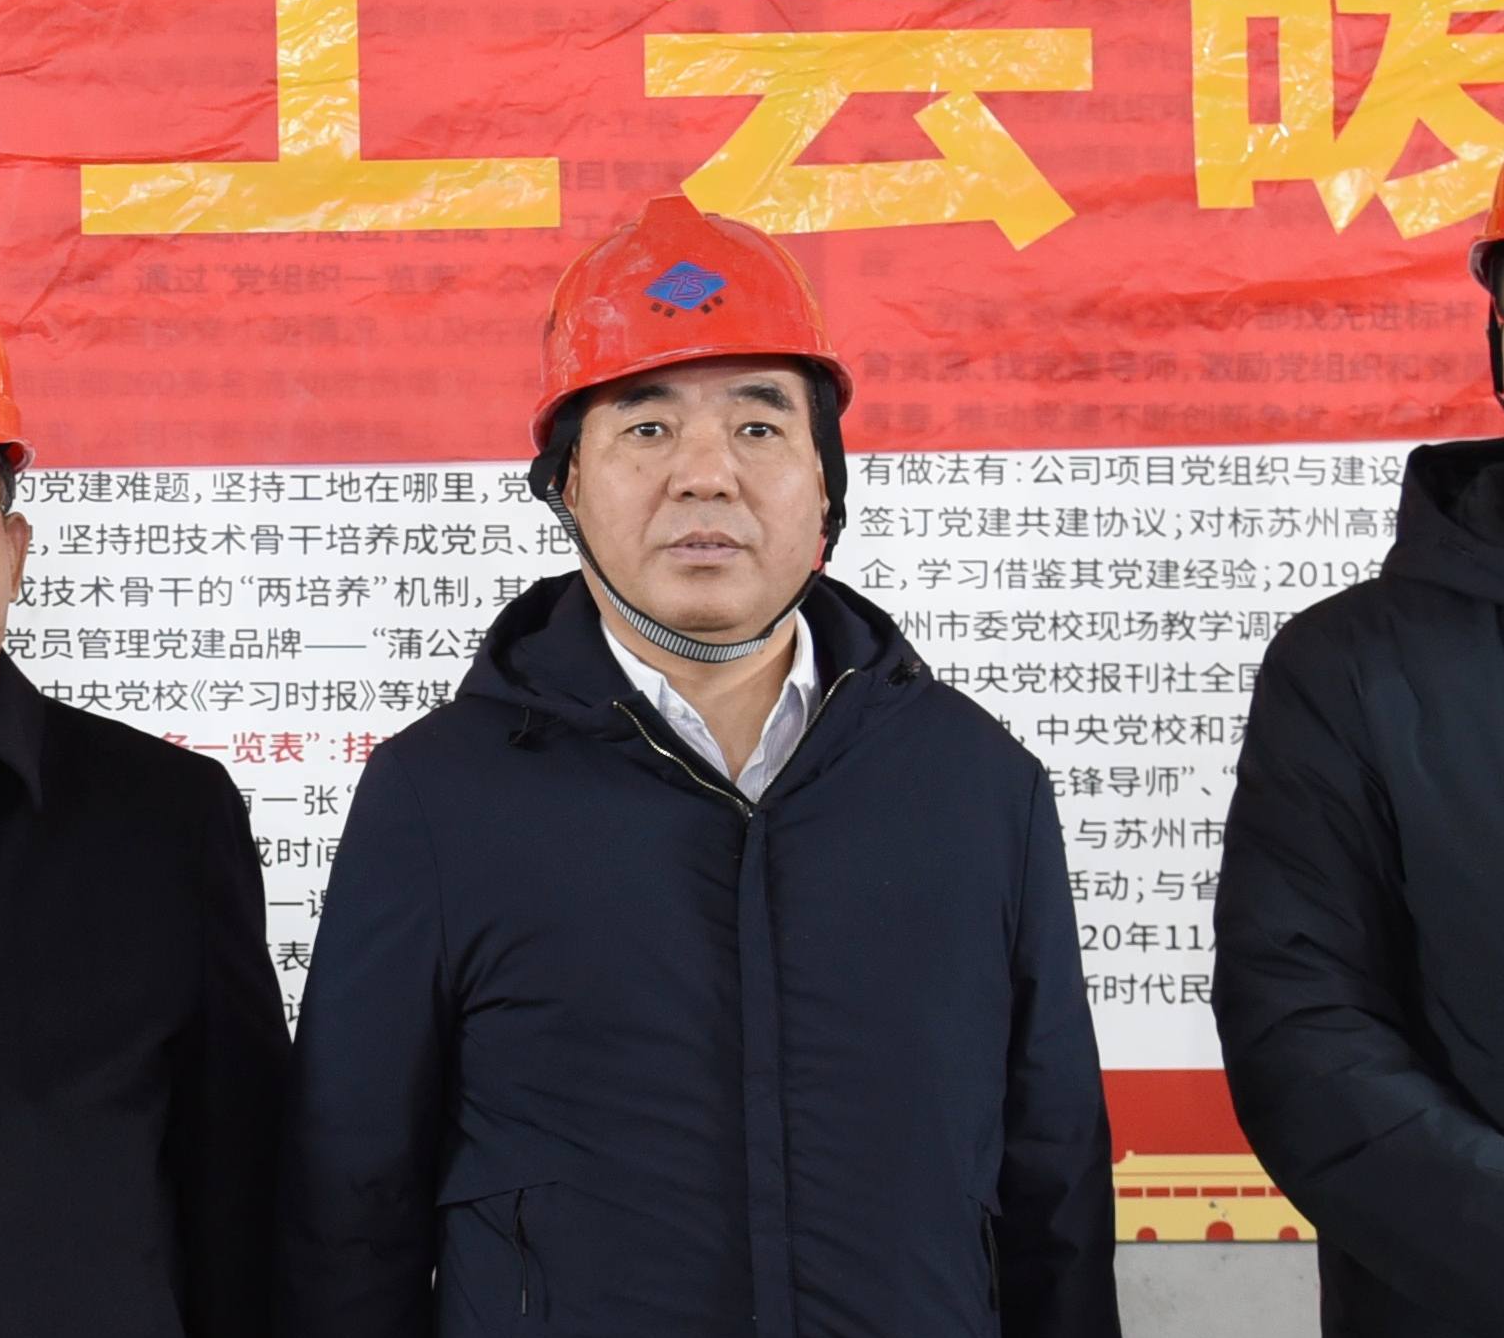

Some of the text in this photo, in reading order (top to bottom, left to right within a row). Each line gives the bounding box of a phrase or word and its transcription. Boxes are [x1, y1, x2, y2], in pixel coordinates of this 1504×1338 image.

[15, 574, 542, 608] 成技术骨干的“两培养”机制，其
[889, 610, 1296, 644] 州市委党校现场教学调研
[1080, 921, 1216, 954] 20年11
